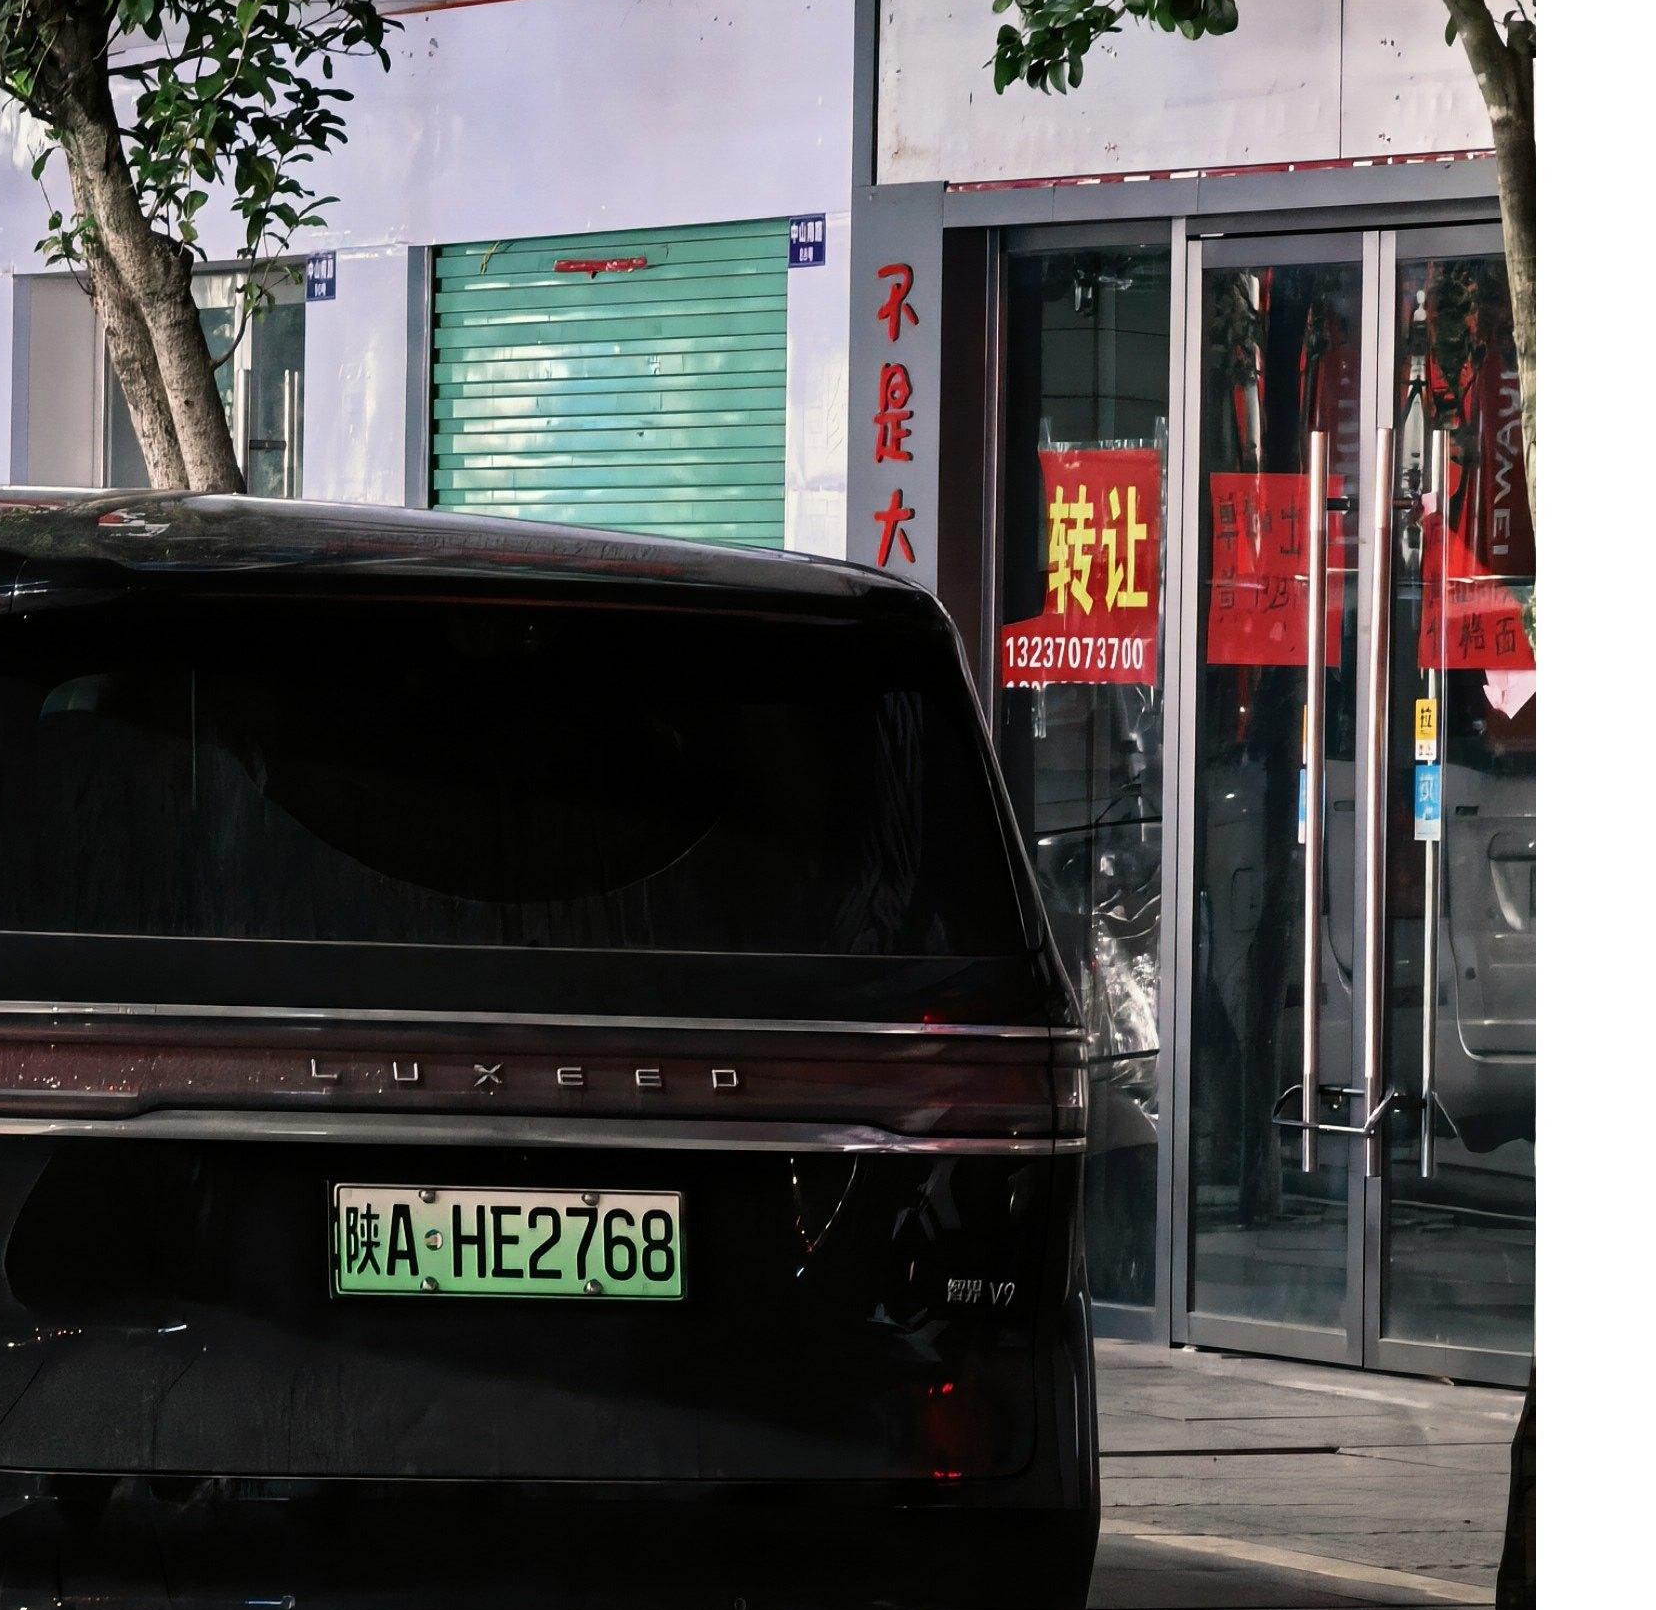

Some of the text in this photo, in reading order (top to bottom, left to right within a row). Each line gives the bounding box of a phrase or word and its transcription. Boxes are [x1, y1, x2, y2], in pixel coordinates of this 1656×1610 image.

[872, 263, 920, 568] 不是大
[1047, 484, 1149, 616] 转让
[1005, 635, 1144, 670] 13237073700
[310, 1057, 740, 1091] LUXEED
[345, 1202, 676, 1282] 陕A HE2768
